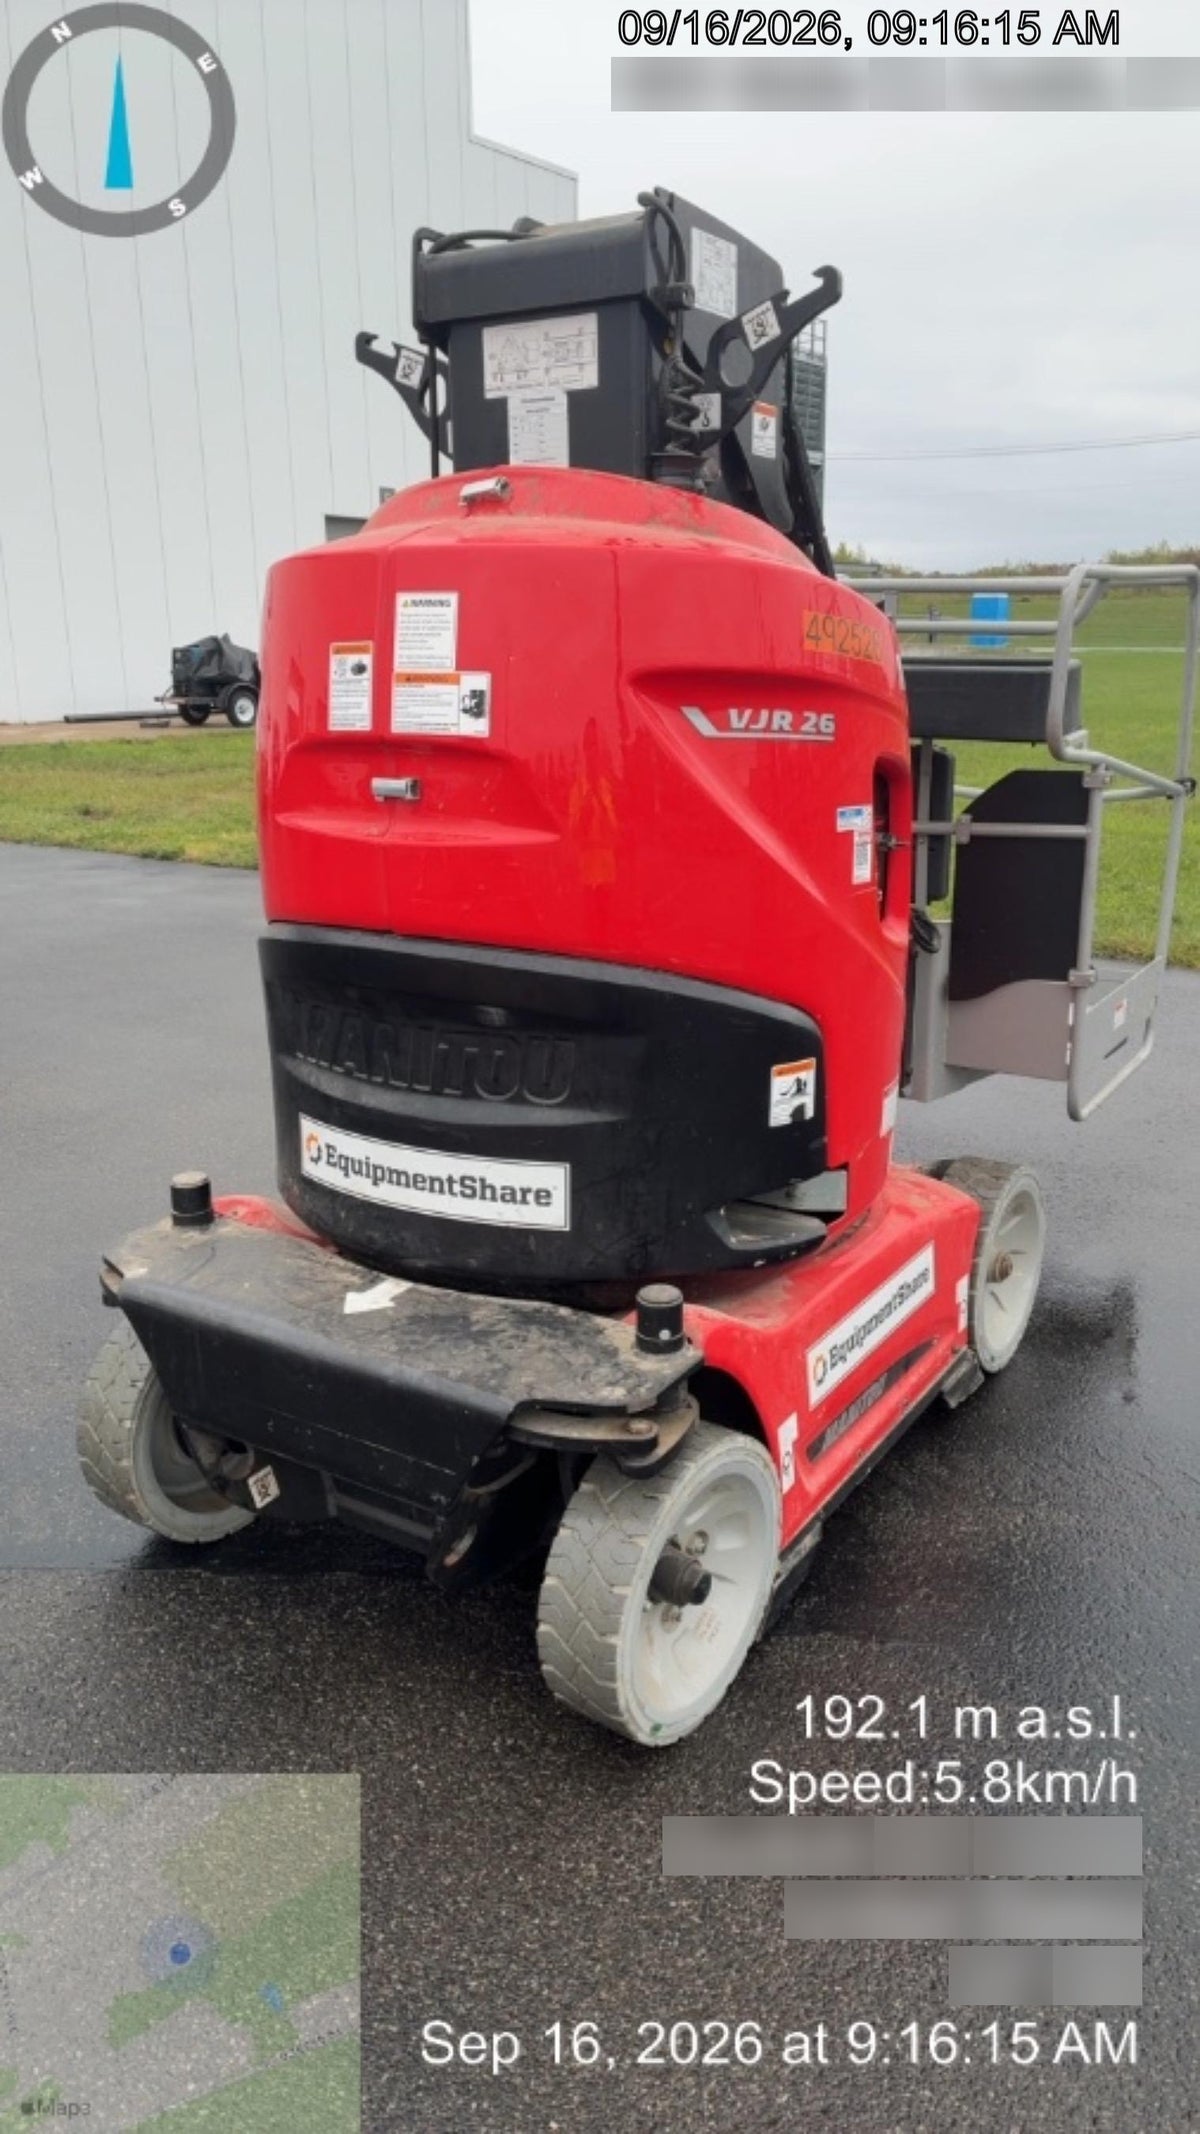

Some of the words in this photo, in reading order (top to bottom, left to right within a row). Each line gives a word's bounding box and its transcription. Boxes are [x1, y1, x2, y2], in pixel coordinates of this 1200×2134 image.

[729, 708, 793, 732] VJR
[801, 711, 836, 734] 26
[325, 1143, 553, 1206] EquipmentShare
